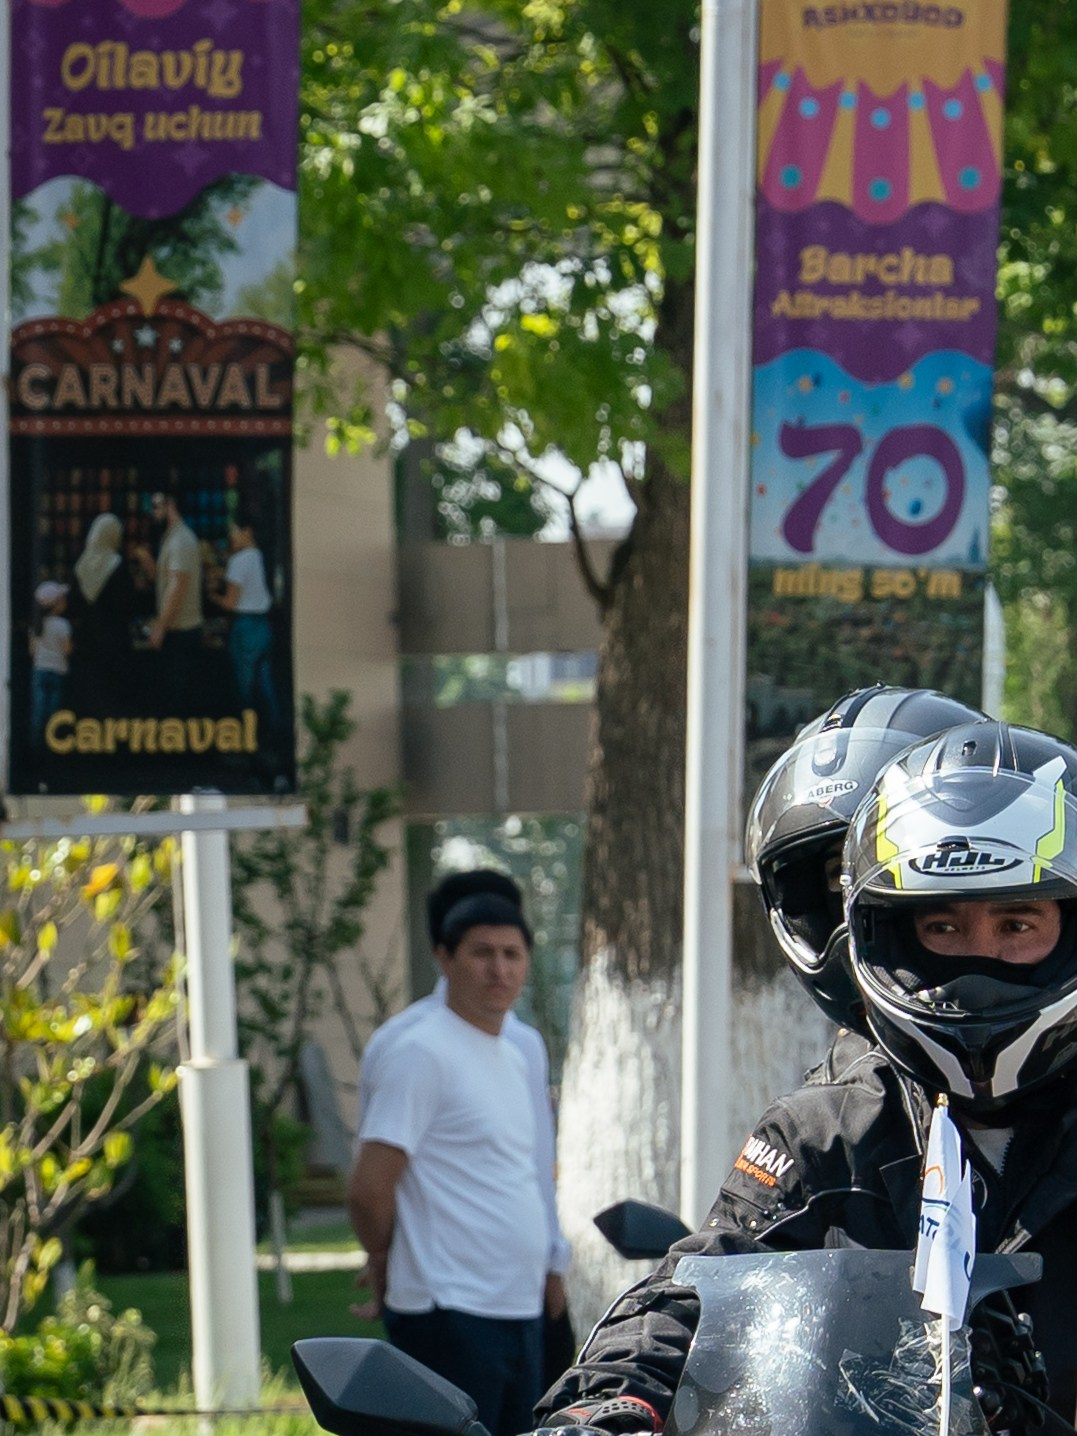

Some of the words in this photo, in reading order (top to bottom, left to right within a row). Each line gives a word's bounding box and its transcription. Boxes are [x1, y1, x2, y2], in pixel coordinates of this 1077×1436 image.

[42, 106, 136, 151] Zavq
[143, 105, 263, 141] uchun
[799, 245, 955, 286] Barcha
[17, 362, 283, 411] CARNAVAL
[778, 420, 965, 555] 70
[45, 708, 259, 754] Carnaval
[808, 781, 854, 798] ABERG
